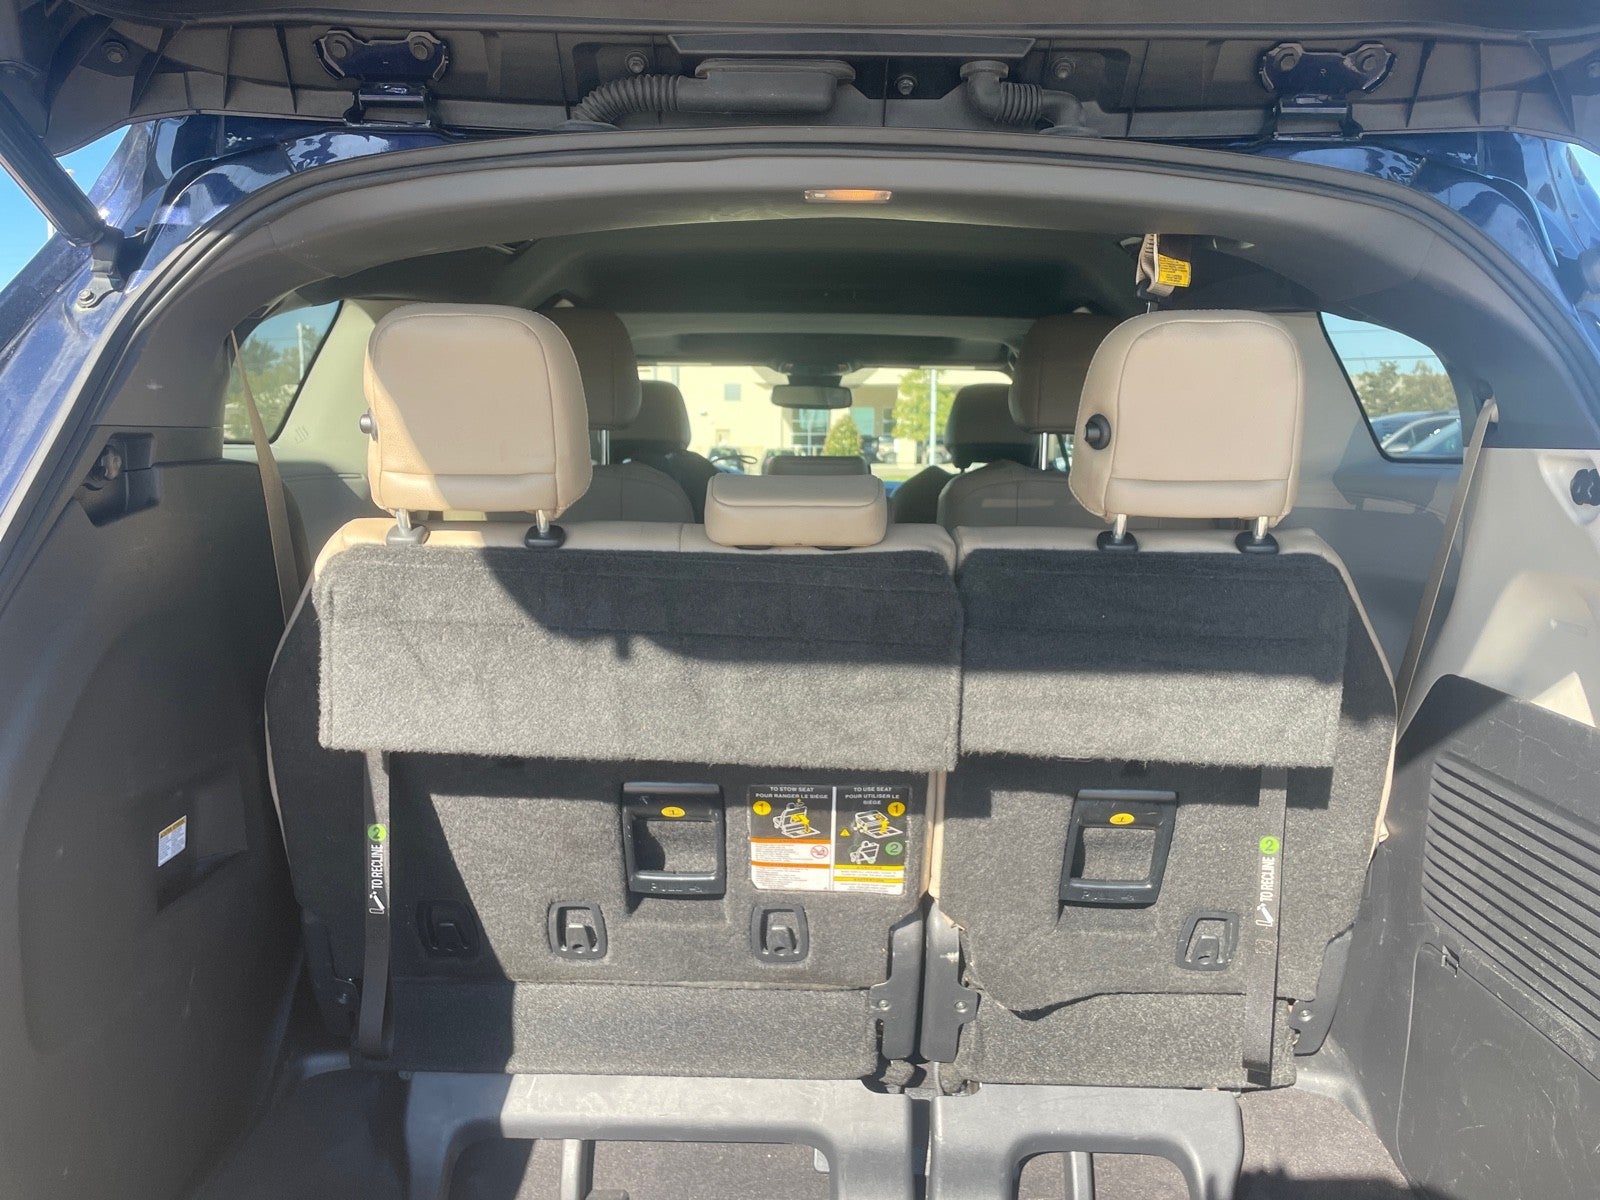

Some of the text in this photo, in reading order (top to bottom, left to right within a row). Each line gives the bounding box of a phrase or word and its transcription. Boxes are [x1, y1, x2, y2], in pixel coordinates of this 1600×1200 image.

[372, 826, 381, 840] 2
[1264, 839, 1274, 852] 2
[371, 844, 384, 890] TO RECLINE
[1260, 856, 1275, 902] TO RECLINE
